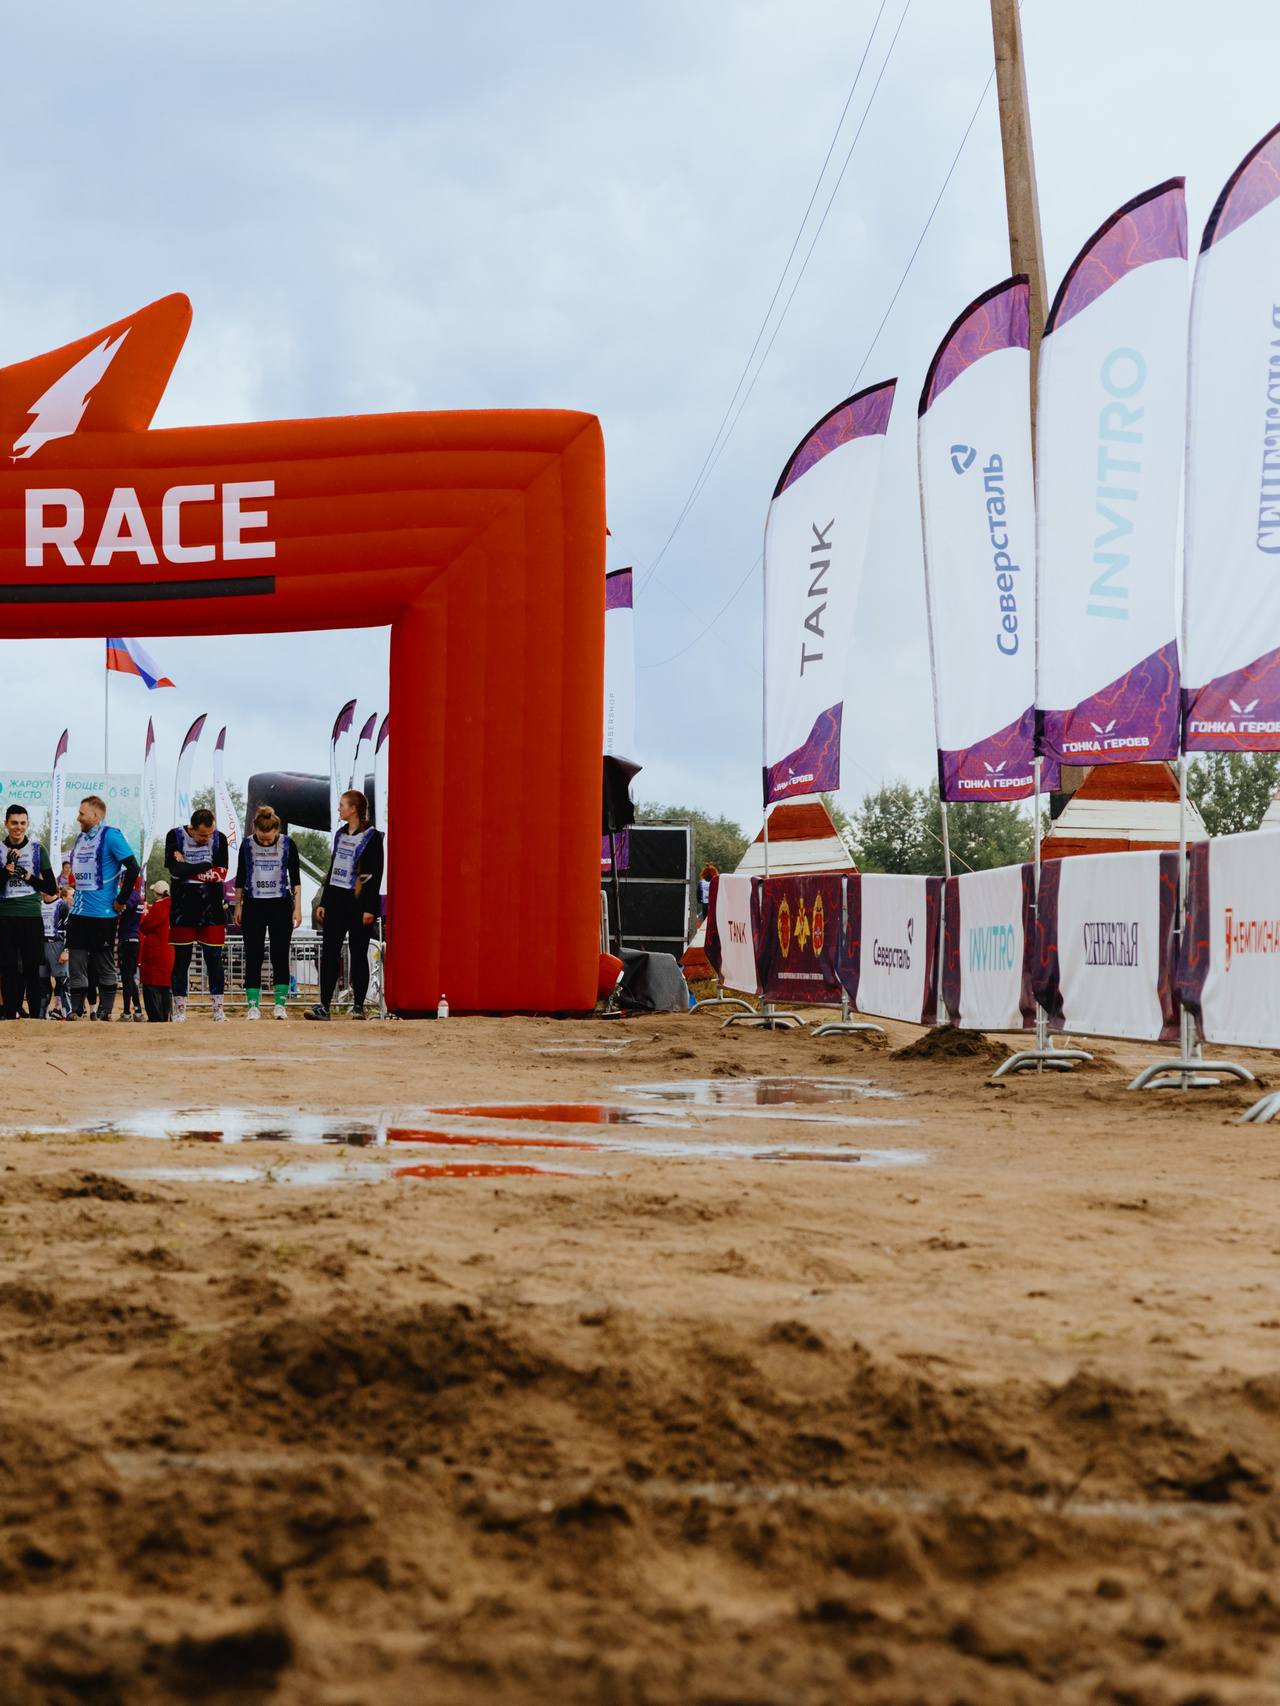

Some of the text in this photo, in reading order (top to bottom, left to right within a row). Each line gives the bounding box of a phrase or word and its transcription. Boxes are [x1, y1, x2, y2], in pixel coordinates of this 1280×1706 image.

[1086, 347, 1147, 620] INVITRO
[25, 480, 276, 567] RACE
[983, 453, 1021, 655] Северсталь
[800, 517, 835, 677] TANK
[607, 693, 616, 755] BARBERSHOP
[1190, 721, 1280, 733] ГОНКА ГЕРОЕ
[1062, 737, 1150, 753] ГОНКА ГЕРОЕВ
[8, 790, 42, 799] МЕСТО
[958, 775, 1034, 789] ГОНКА ГЕРОЕВ
[257, 881, 277, 889] 08505
[728, 920, 747, 945] TANK
[970, 923, 1015, 972] INVITRO
[1083, 922, 1139, 967] СЕНЕЖСКАЯ
[1233, 920, 1280, 954] ЧЕМПИОНА
[873, 938, 911, 975] Северсталь
